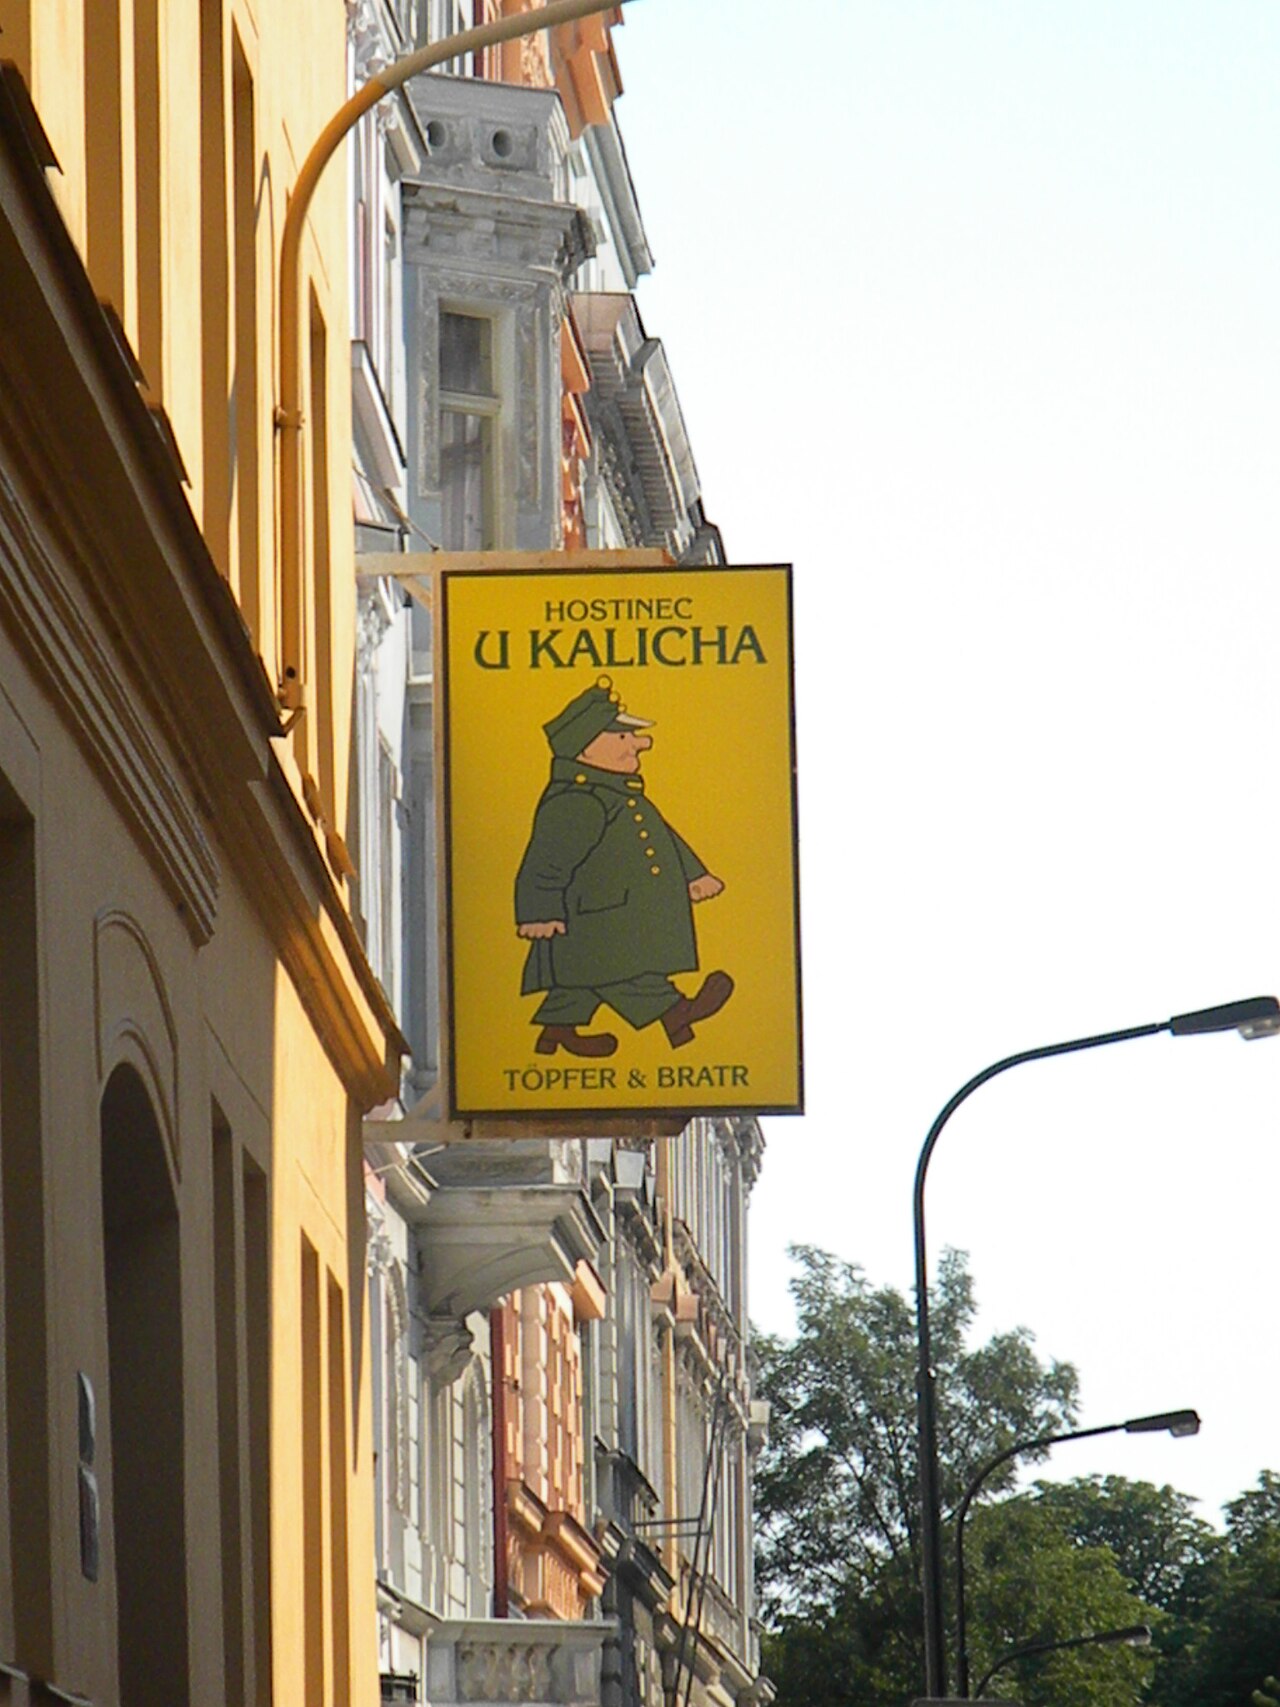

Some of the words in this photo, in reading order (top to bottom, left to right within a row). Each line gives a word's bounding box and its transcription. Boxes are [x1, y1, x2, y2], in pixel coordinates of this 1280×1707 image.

[545, 598, 693, 621] HOSTINEC
[473, 631, 510, 670] U
[530, 625, 767, 669] KALICHA
[503, 1063, 617, 1091] TÖPFER
[627, 1070, 646, 1089] &
[658, 1066, 749, 1088] BRATR
